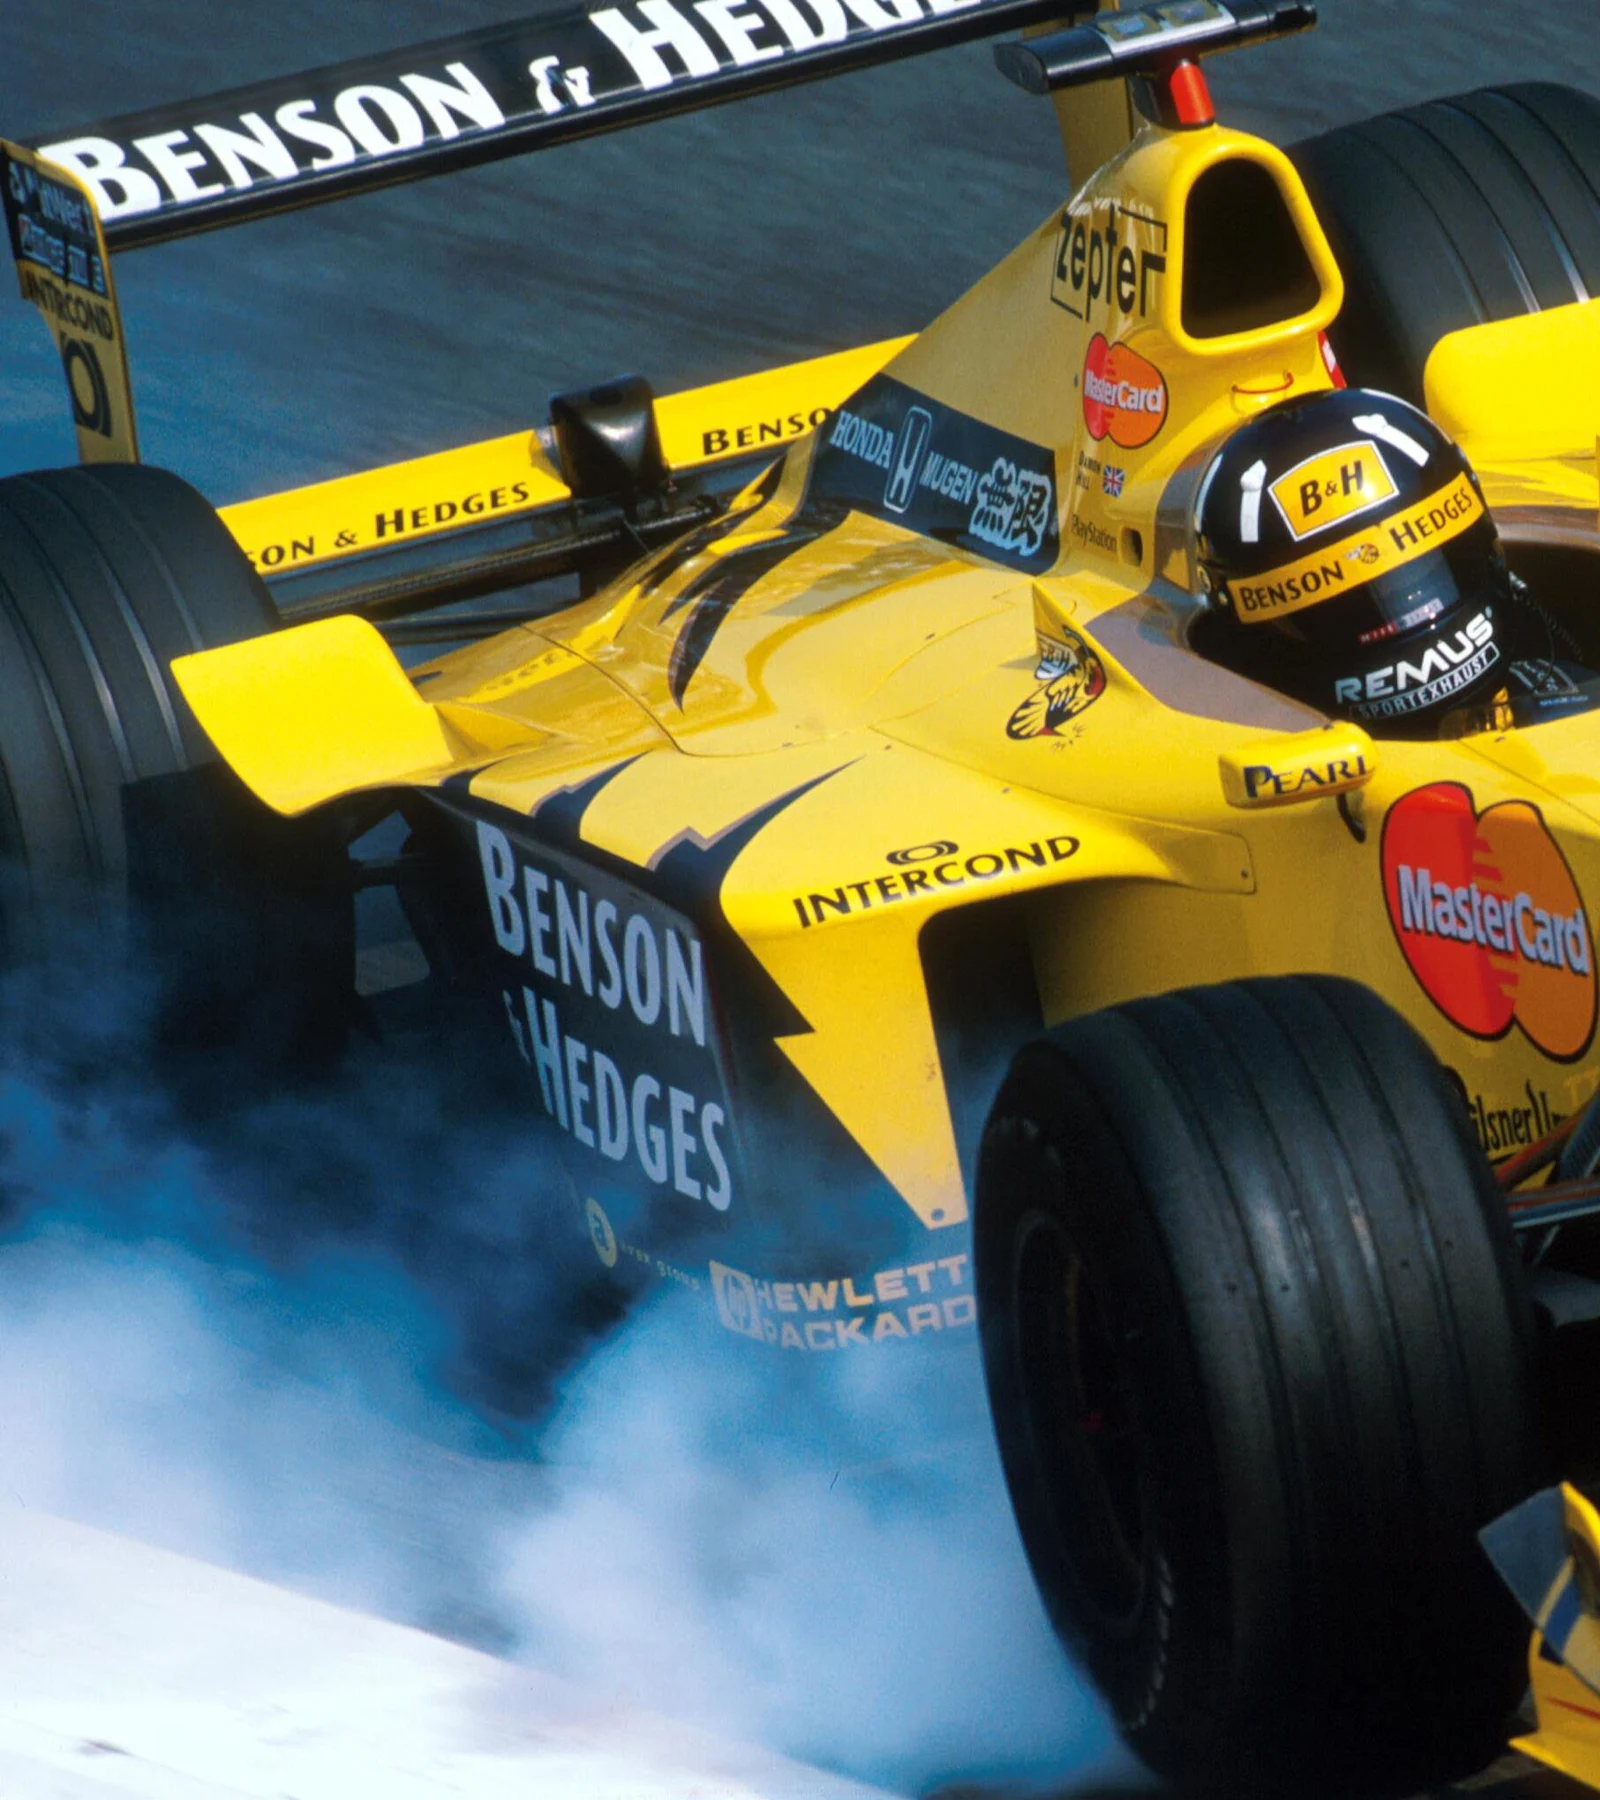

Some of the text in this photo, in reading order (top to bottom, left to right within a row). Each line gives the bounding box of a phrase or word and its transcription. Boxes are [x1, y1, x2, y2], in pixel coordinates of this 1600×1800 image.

[37, 62, 506, 222] BENSON
[526, 56, 596, 115] &
[1057, 201, 1166, 322] zepter
[1085, 369, 1164, 412] MasterCard
[829, 410, 894, 469] HONDA
[919, 452, 979, 505] MUGEN
[1300, 460, 1363, 517] B&H
[333, 529, 358, 548] &
[376, 482, 530, 538] HEDGES
[1239, 487, 1473, 612] BENSON HEDGES
[1335, 612, 1494, 704] REMUS
[1243, 755, 1374, 798] PEARL
[792, 836, 1081, 928] INTERCOND
[1397, 863, 1590, 976] MasterCard
[476, 819, 705, 1047] BENSON
[522, 985, 732, 1211] HEDGES
[754, 1253, 967, 1312] HEWLETT
[763, 1294, 977, 1350] PACKARD
